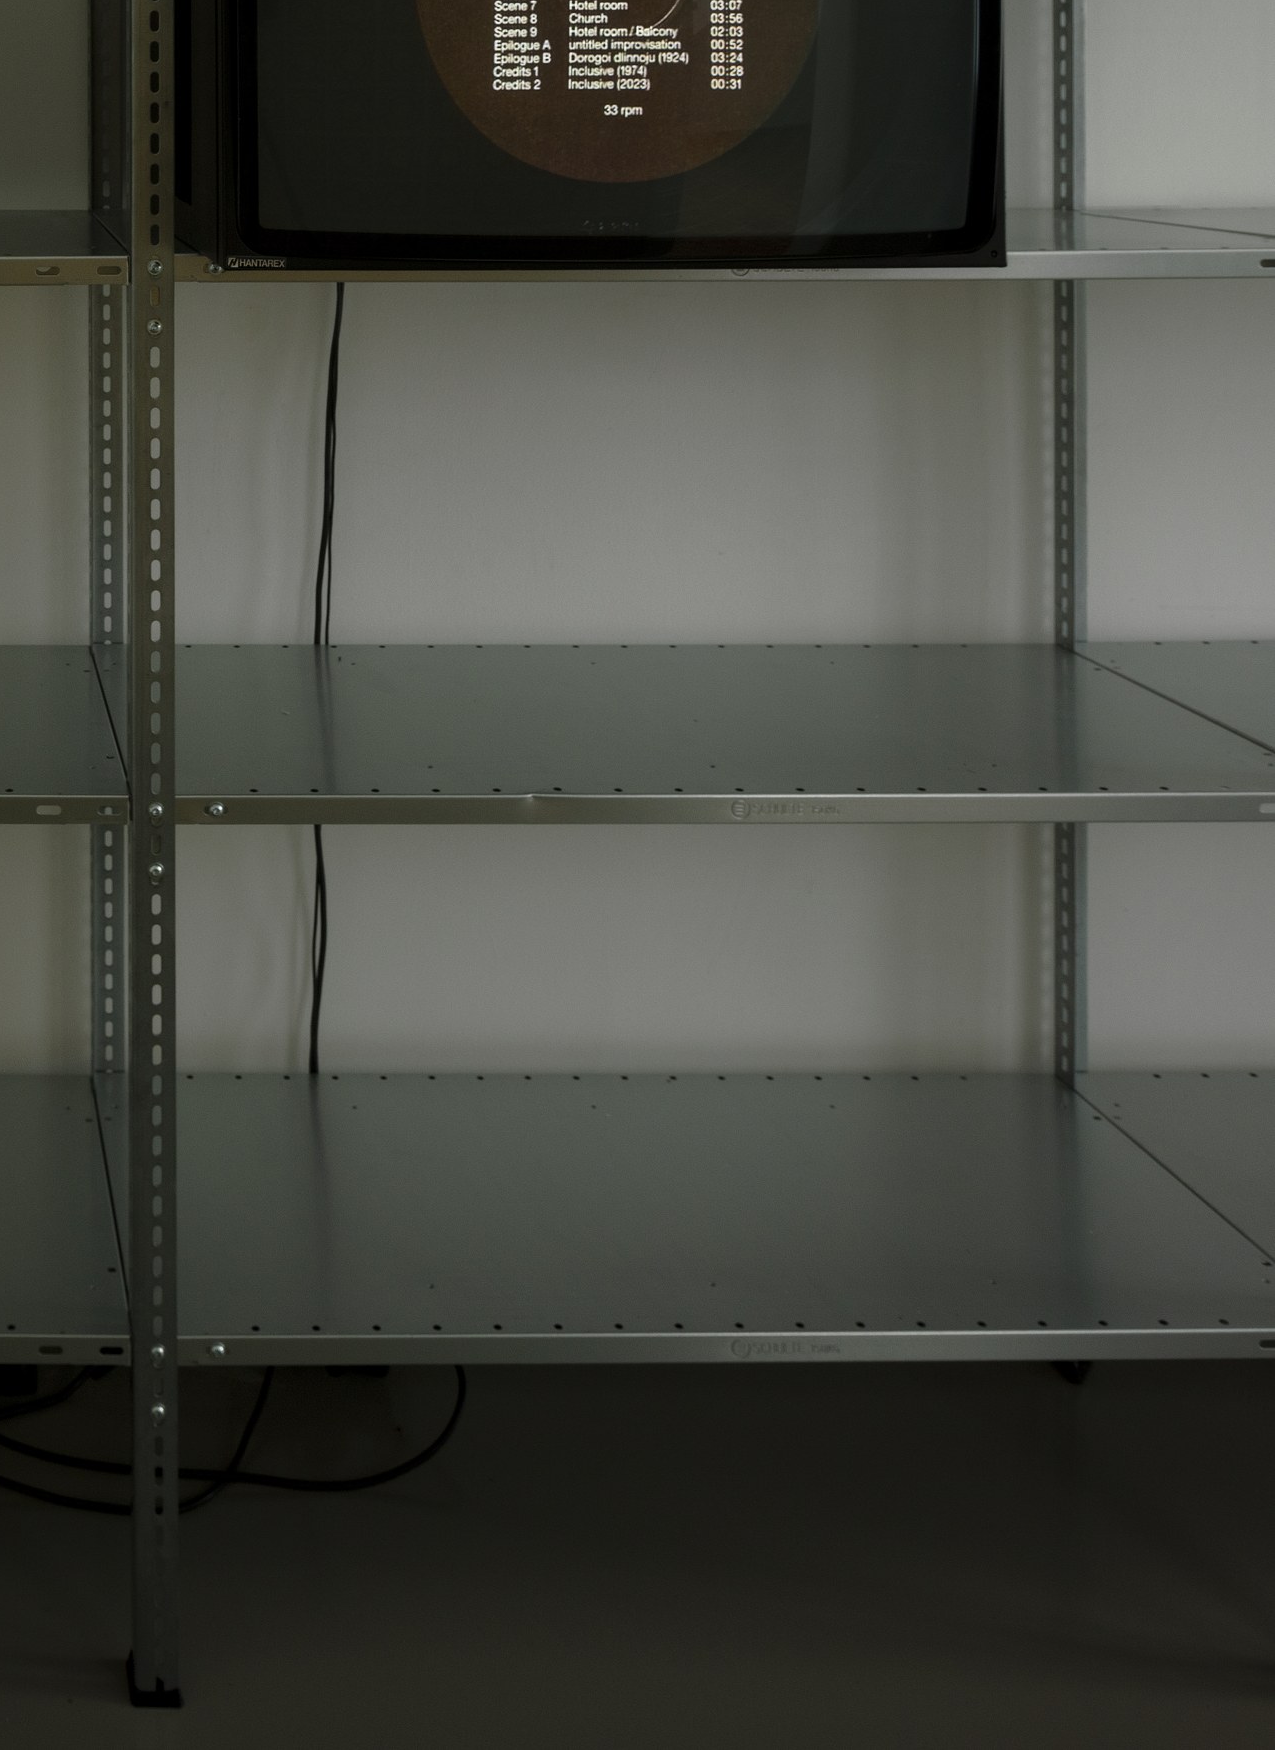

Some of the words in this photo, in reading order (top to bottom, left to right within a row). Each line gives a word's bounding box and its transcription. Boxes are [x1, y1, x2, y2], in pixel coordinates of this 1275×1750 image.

[494, 1, 528, 11] Scene
[530, 1, 538, 11] 7
[569, 1, 597, 11] Hotel
[600, 1, 628, 11] room
[710, 1, 743, 11] 03:07
[494, 14, 528, 24] Scene
[530, 14, 538, 24] 8
[569, 14, 608, 24] Church
[711, 14, 743, 24] 03:56
[494, 27, 528, 37] Scene
[530, 27, 538, 37] 9
[569, 27, 597, 37] Hotel
[600, 27, 628, 37] room
[711, 27, 743, 37] 02:03
[494, 40, 540, 53] Epilogue
[542, 40, 551, 50] A
[569, 40, 609, 50] untitled
[611, 40, 681, 53] improvisation
[711, 40, 743, 50] 00:52
[494, 53, 540, 66] Epilogue
[542, 53, 552, 63] B
[569, 53, 612, 66] Dorogoi
[614, 53, 656, 66] dlinnoju
[658, 53, 689, 65] (1924)
[711, 53, 743, 63] 03:24
[493, 66, 532, 76] Credits
[533, 66, 539, 76] 1
[569, 66, 615, 76] Inclusive
[617, 66, 648, 78] (1974)
[711, 66, 744, 76] 00:28
[493, 80, 532, 90] Credits
[533, 80, 541, 90] 2
[569, 80, 615, 90] Inclusive
[617, 80, 651, 92] (2023)
[711, 80, 742, 90] 00:31
[604, 105, 618, 116] 33
[621, 106, 643, 118] rpm
[240, 259, 285, 267] HANTAREX
